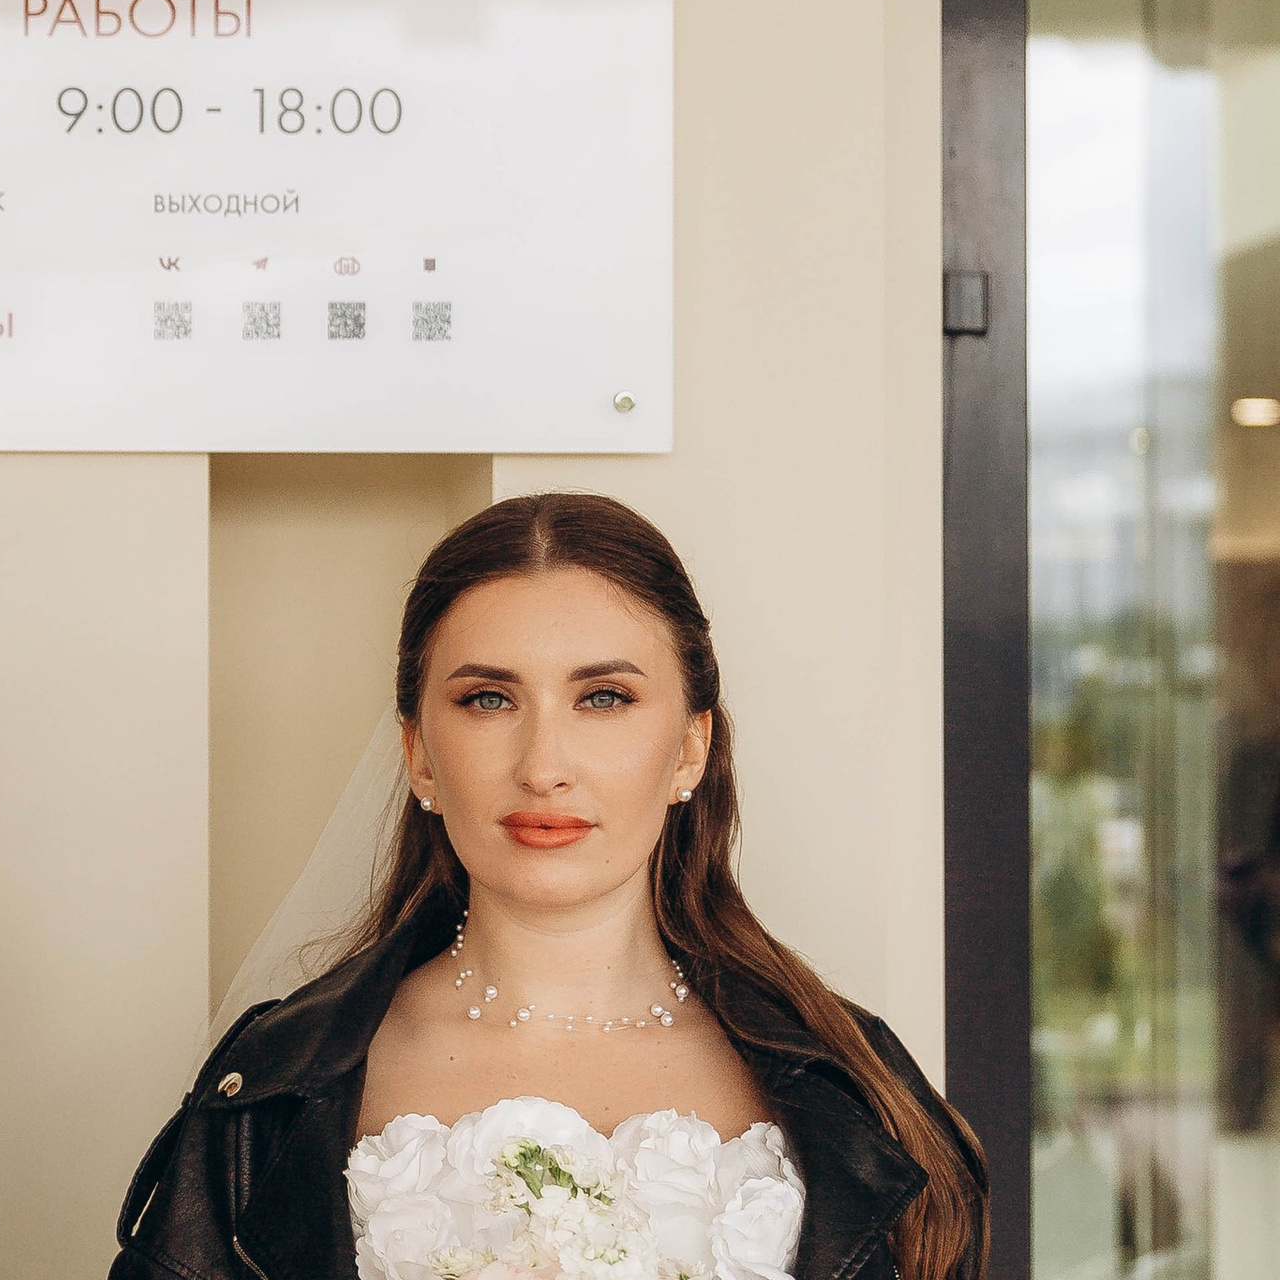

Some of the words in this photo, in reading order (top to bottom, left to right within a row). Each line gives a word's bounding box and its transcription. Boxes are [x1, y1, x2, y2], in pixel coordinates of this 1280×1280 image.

[56, 86, 184, 135] 9:00
[252, 87, 403, 136] 18:00
[153, 189, 300, 216] ВЫХОДНОЙ
